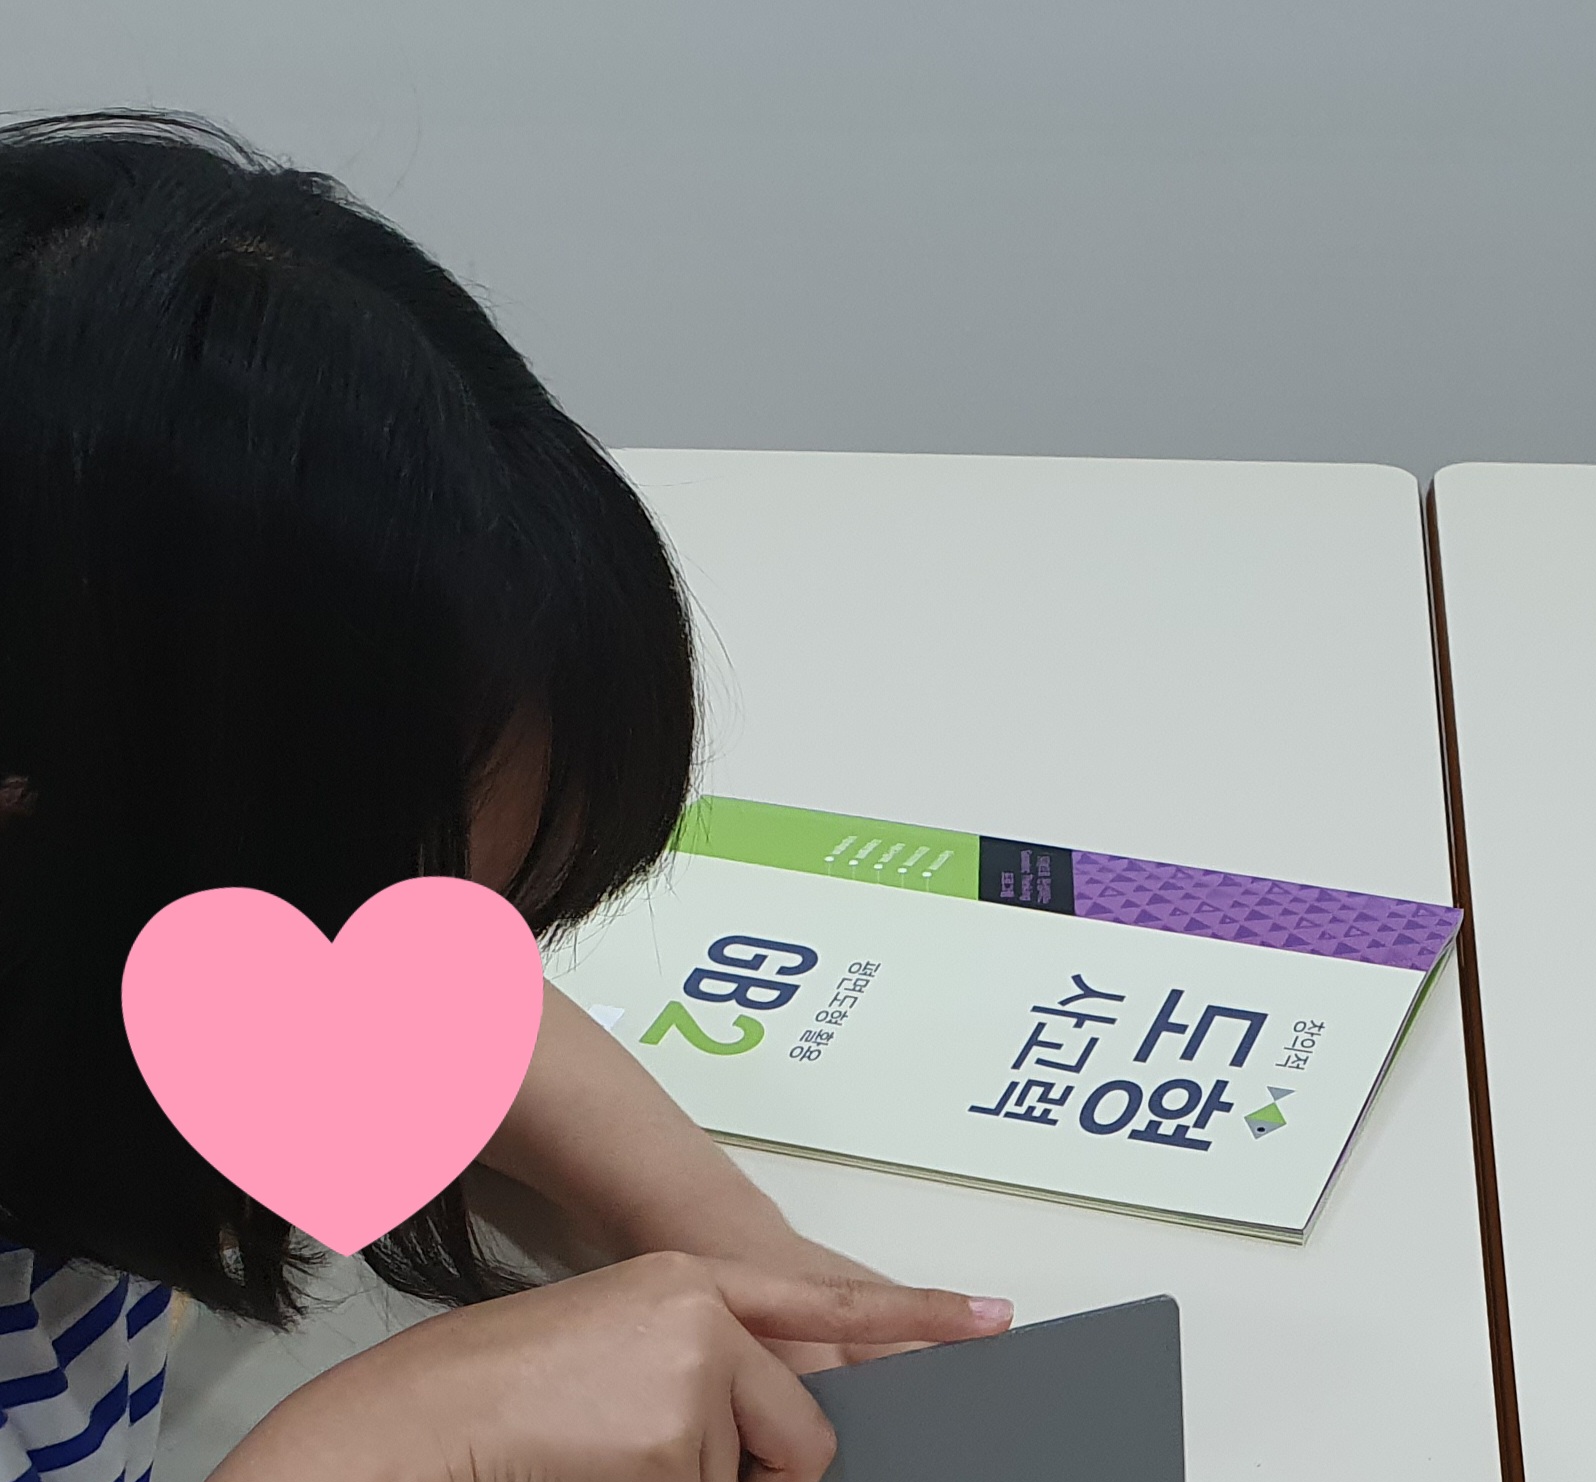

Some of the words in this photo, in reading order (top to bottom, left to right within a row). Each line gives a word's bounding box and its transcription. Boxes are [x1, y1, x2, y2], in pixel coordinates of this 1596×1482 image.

[639, 935, 818, 1056] GB2
[815, 960, 881, 1026] 평면도형
[788, 1029, 835, 1062] 활용
[967, 973, 1127, 1126] 사고력
[1079, 988, 1269, 1151] 도형
[1275, 1020, 1326, 1070] 창의적
